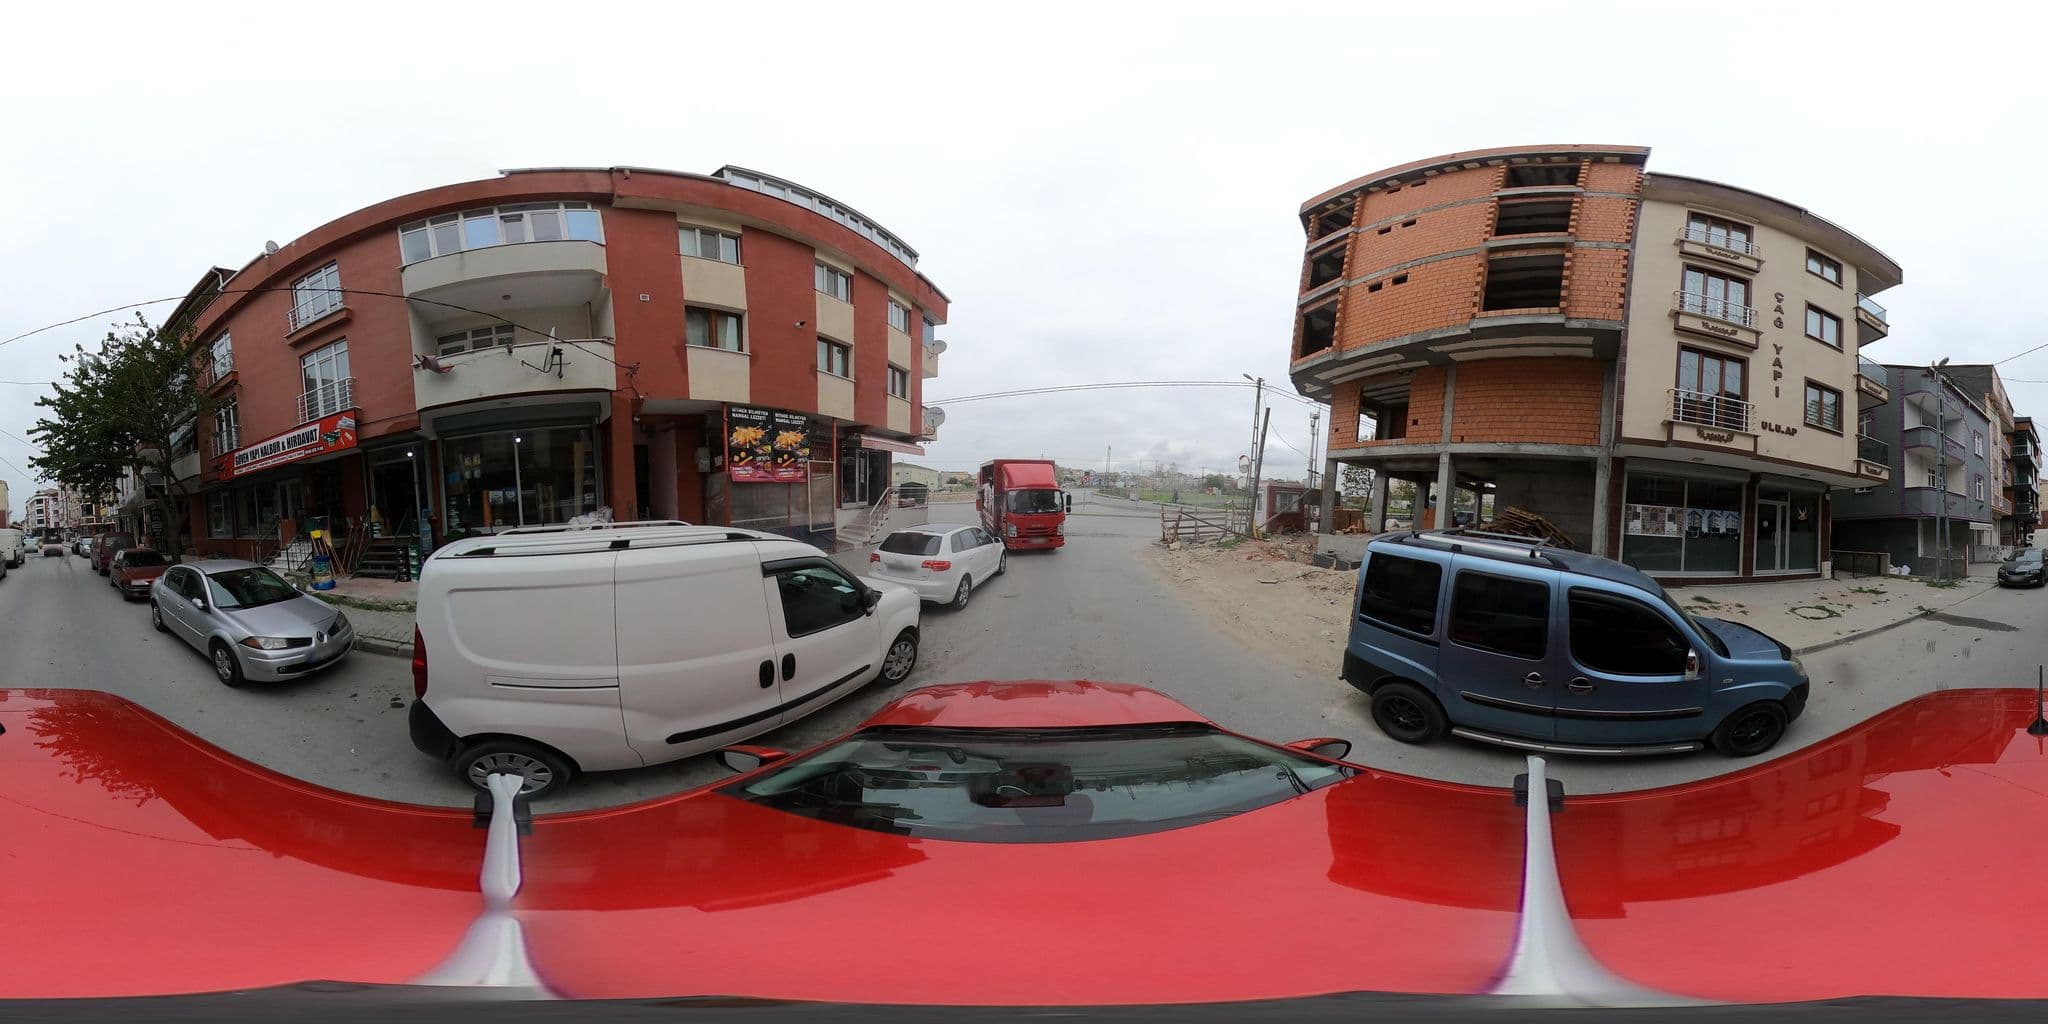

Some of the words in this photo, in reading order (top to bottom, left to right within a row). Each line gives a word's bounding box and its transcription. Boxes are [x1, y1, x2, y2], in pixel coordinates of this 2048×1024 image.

[1773, 343, 1783, 398] YAPI
[260, 441, 280, 457] NALBUR
[286, 428, 318, 449] HIRDAVAT
